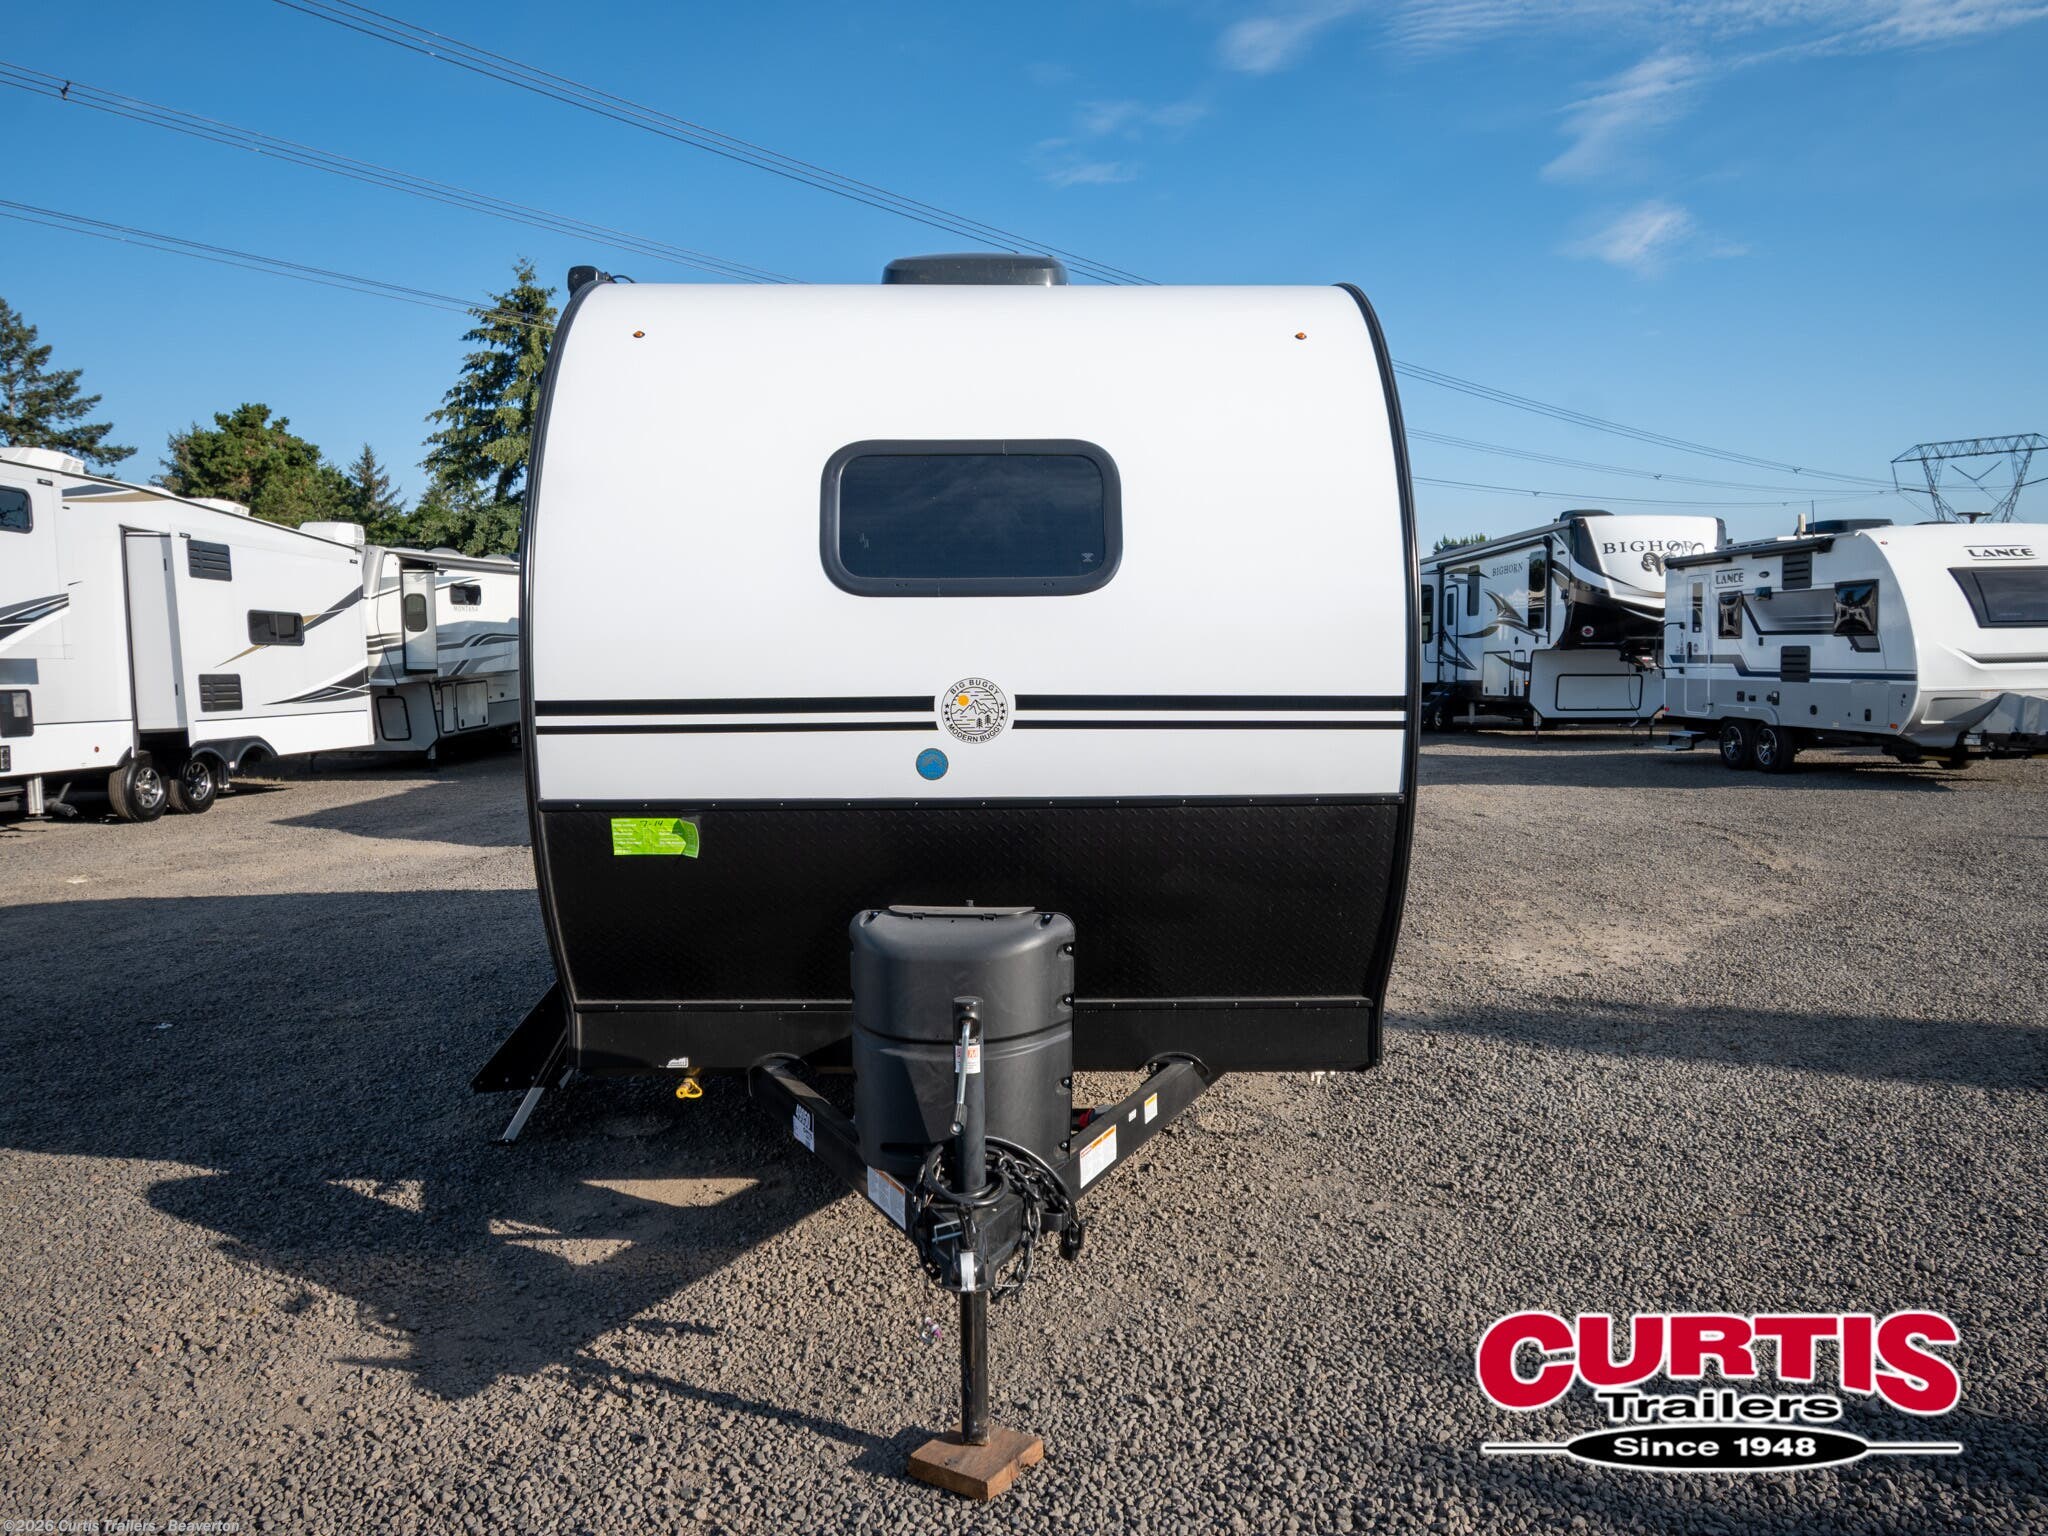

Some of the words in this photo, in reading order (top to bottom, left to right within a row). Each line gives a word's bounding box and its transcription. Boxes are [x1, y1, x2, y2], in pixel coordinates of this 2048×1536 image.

[1967, 548, 2036, 557] LANCE
[1492, 562, 1523, 577] BIGHORN
[1715, 572, 1744, 585] LANCE
[950, 682, 966, 695] BIG
[968, 679, 1000, 695] BUGGY
[947, 723, 979, 742] MODERN
[980, 722, 1003, 742] BUGGY
